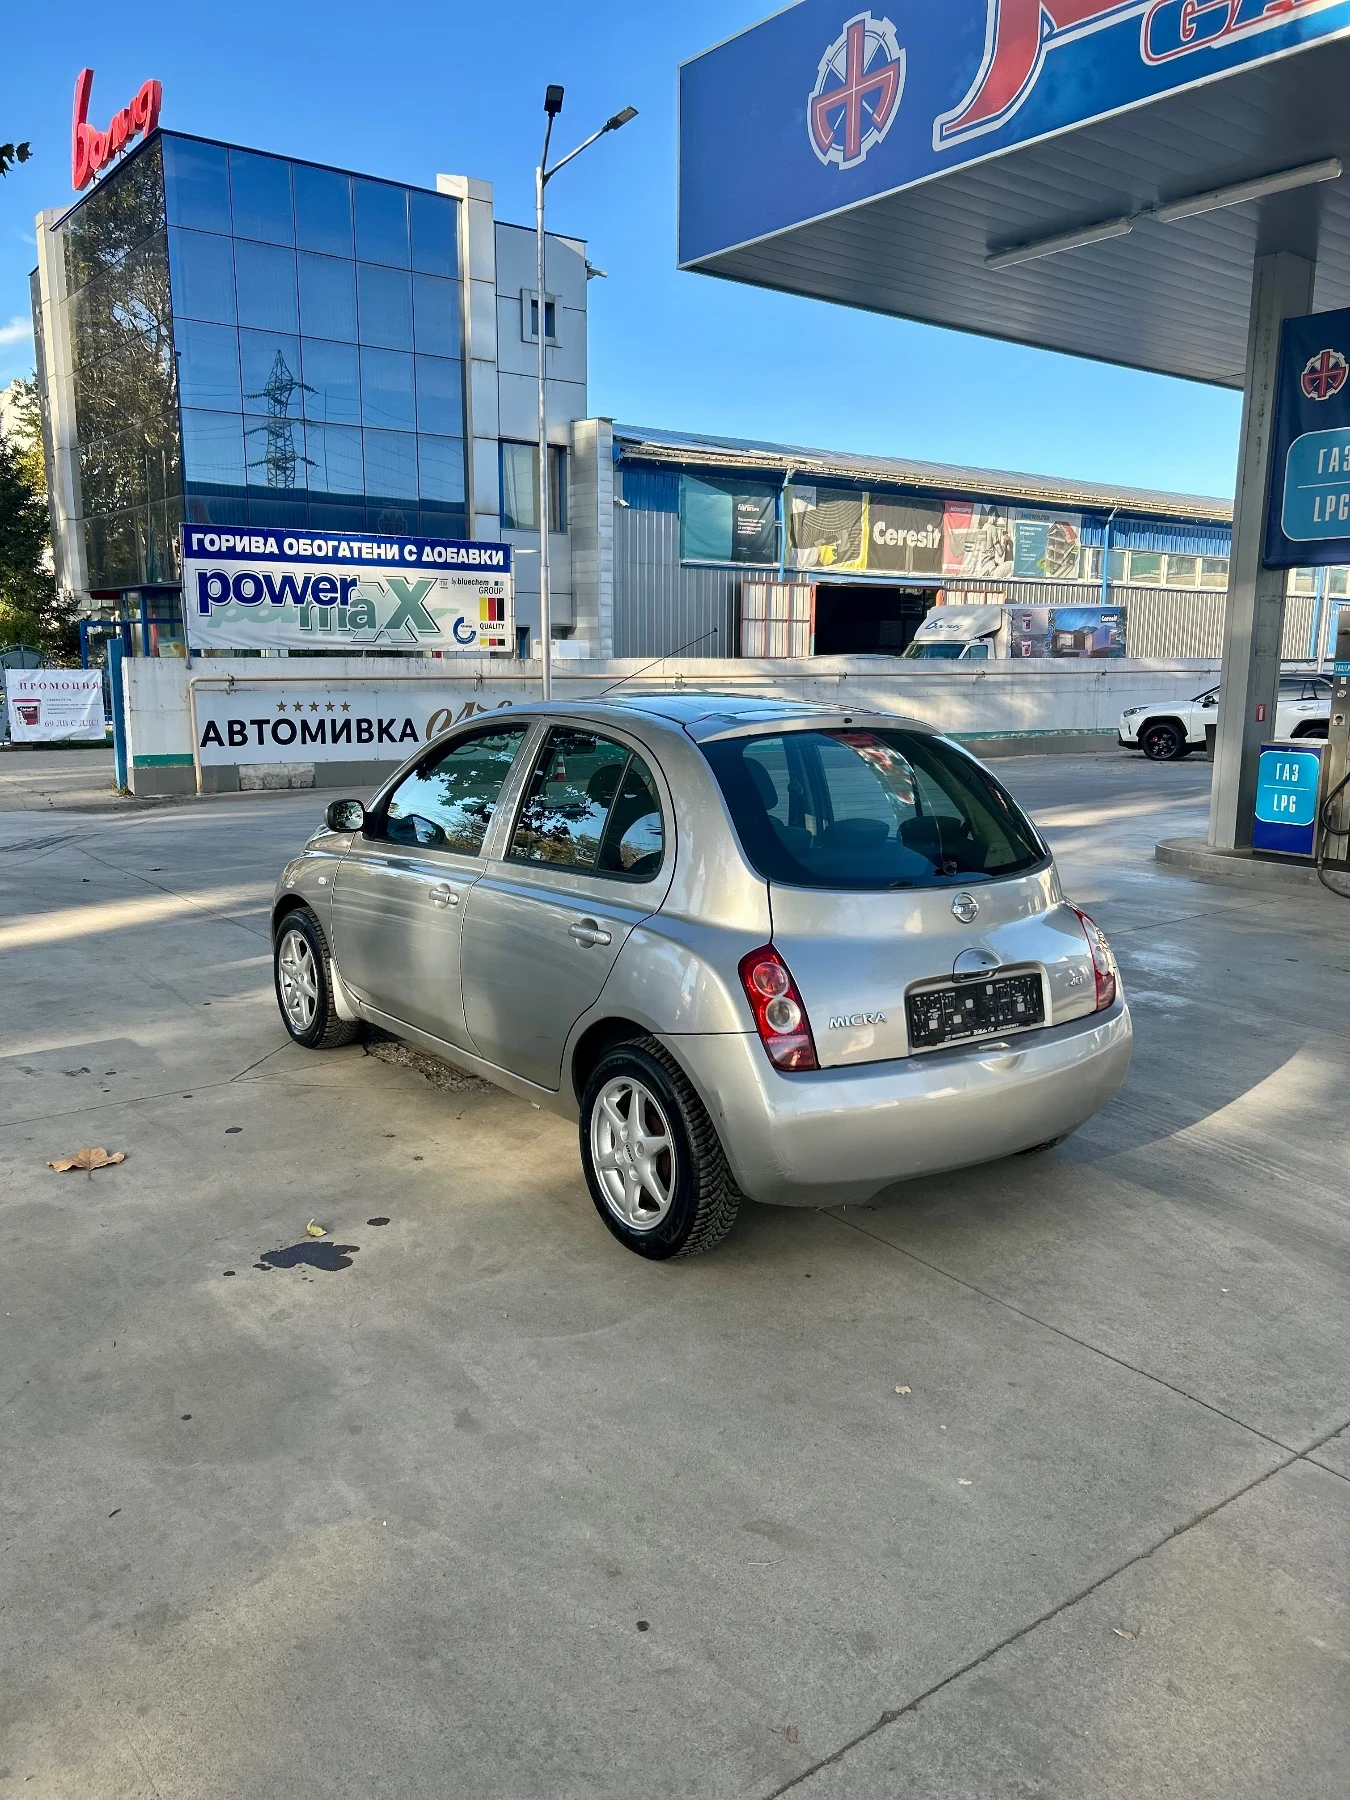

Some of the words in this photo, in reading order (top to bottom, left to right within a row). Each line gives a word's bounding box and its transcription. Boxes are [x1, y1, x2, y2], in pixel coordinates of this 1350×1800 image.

[1317, 445, 1350, 474] ГАЗ
[1313, 493, 1350, 522] LPG
[872, 521, 941, 549] Ceresit
[191, 533, 279, 554] ГОРИВА
[283, 537, 399, 560] ОБОГАТЕНИ
[403, 544, 417, 562] С
[421, 546, 504, 566] ДОБАВКИ
[457, 577, 490, 587] bluechem
[478, 586, 504, 595] GROUP
[196, 569, 358, 616] power
[479, 622, 505, 631] QUALITY
[19, 681, 100, 691] ПРОМОЦИЯ
[200, 717, 420, 748] АВТОМИВКА
[1275, 762, 1300, 782] ГАЗ
[1273, 793, 1297, 813] LPG
[829, 1011, 887, 1029] MICRA
